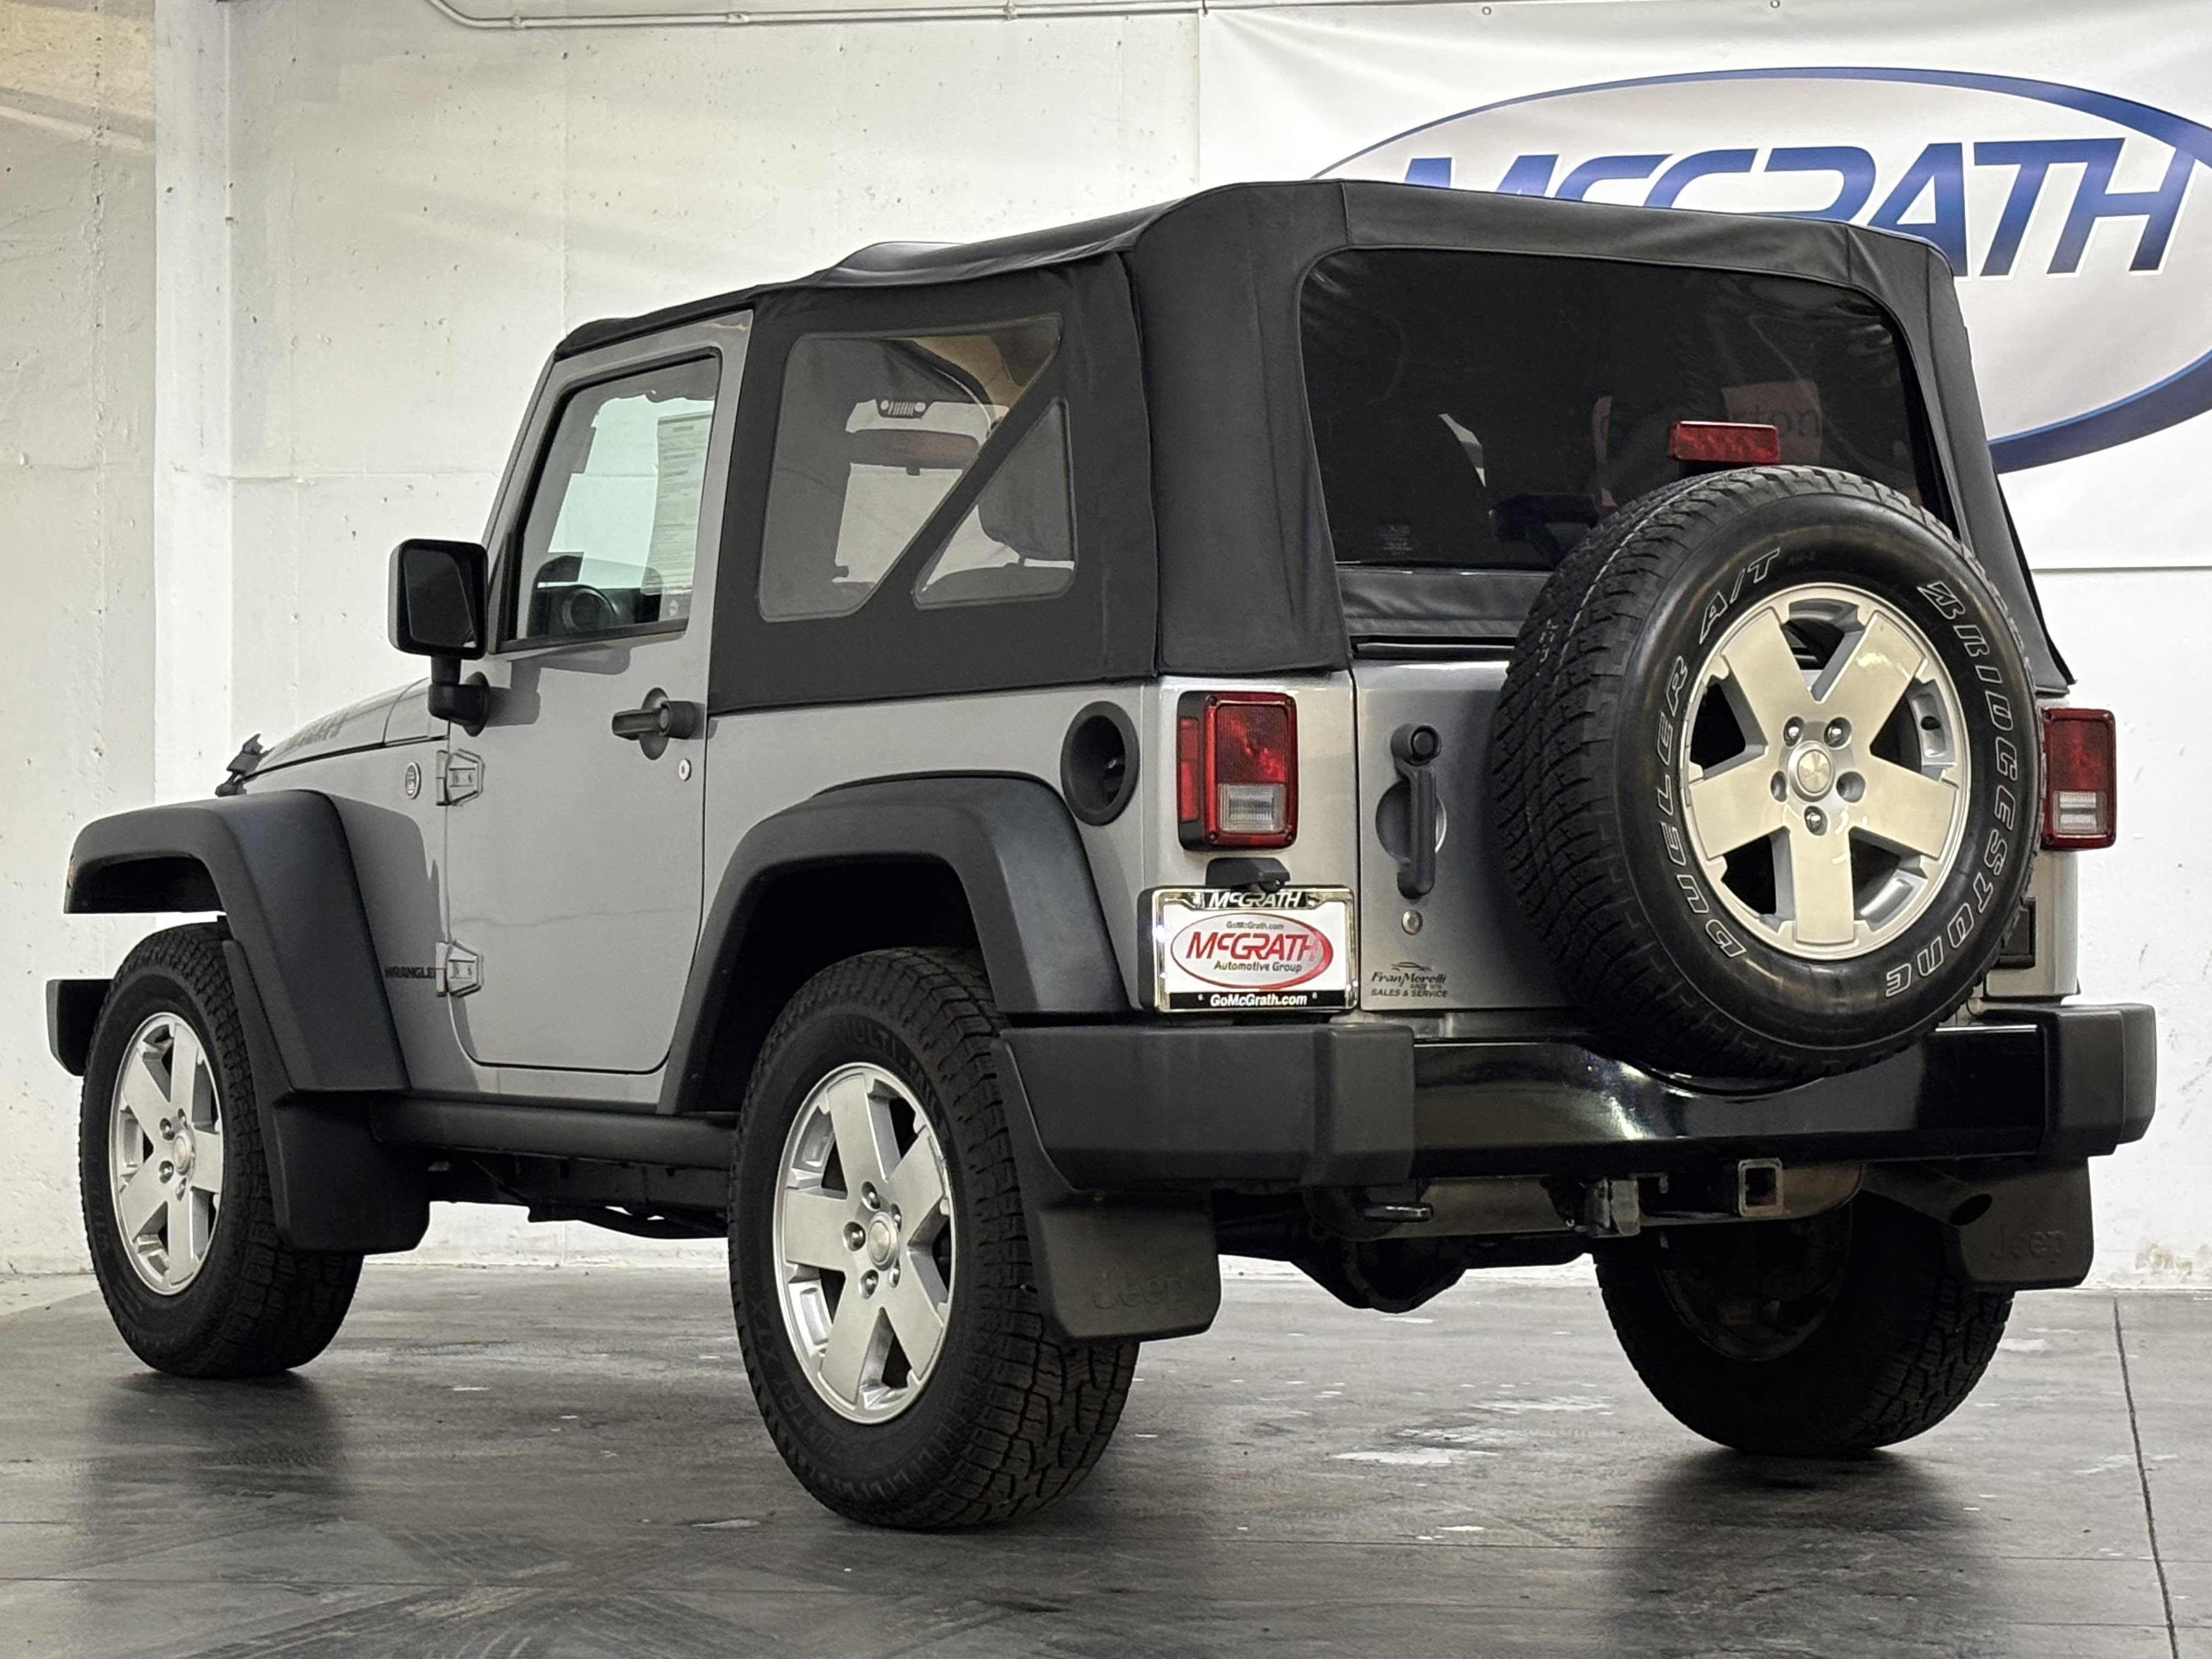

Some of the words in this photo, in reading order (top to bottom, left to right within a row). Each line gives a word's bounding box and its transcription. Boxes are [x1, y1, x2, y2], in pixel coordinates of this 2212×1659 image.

[1700, 548, 1780, 645] A/T
[1885, 580, 2017, 997] BRIDGESTONE
[1657, 656, 1746, 957] DUELER
[385, 966, 436, 979] WRANGLE
[1214, 961, 1269, 971] Automotive
[1272, 961, 1302, 973] Group
[1370, 989, 1401, 997] SALES
[1410, 990, 1448, 998] SERVICE
[1210, 994, 1307, 1007] GoMcGrath.com
